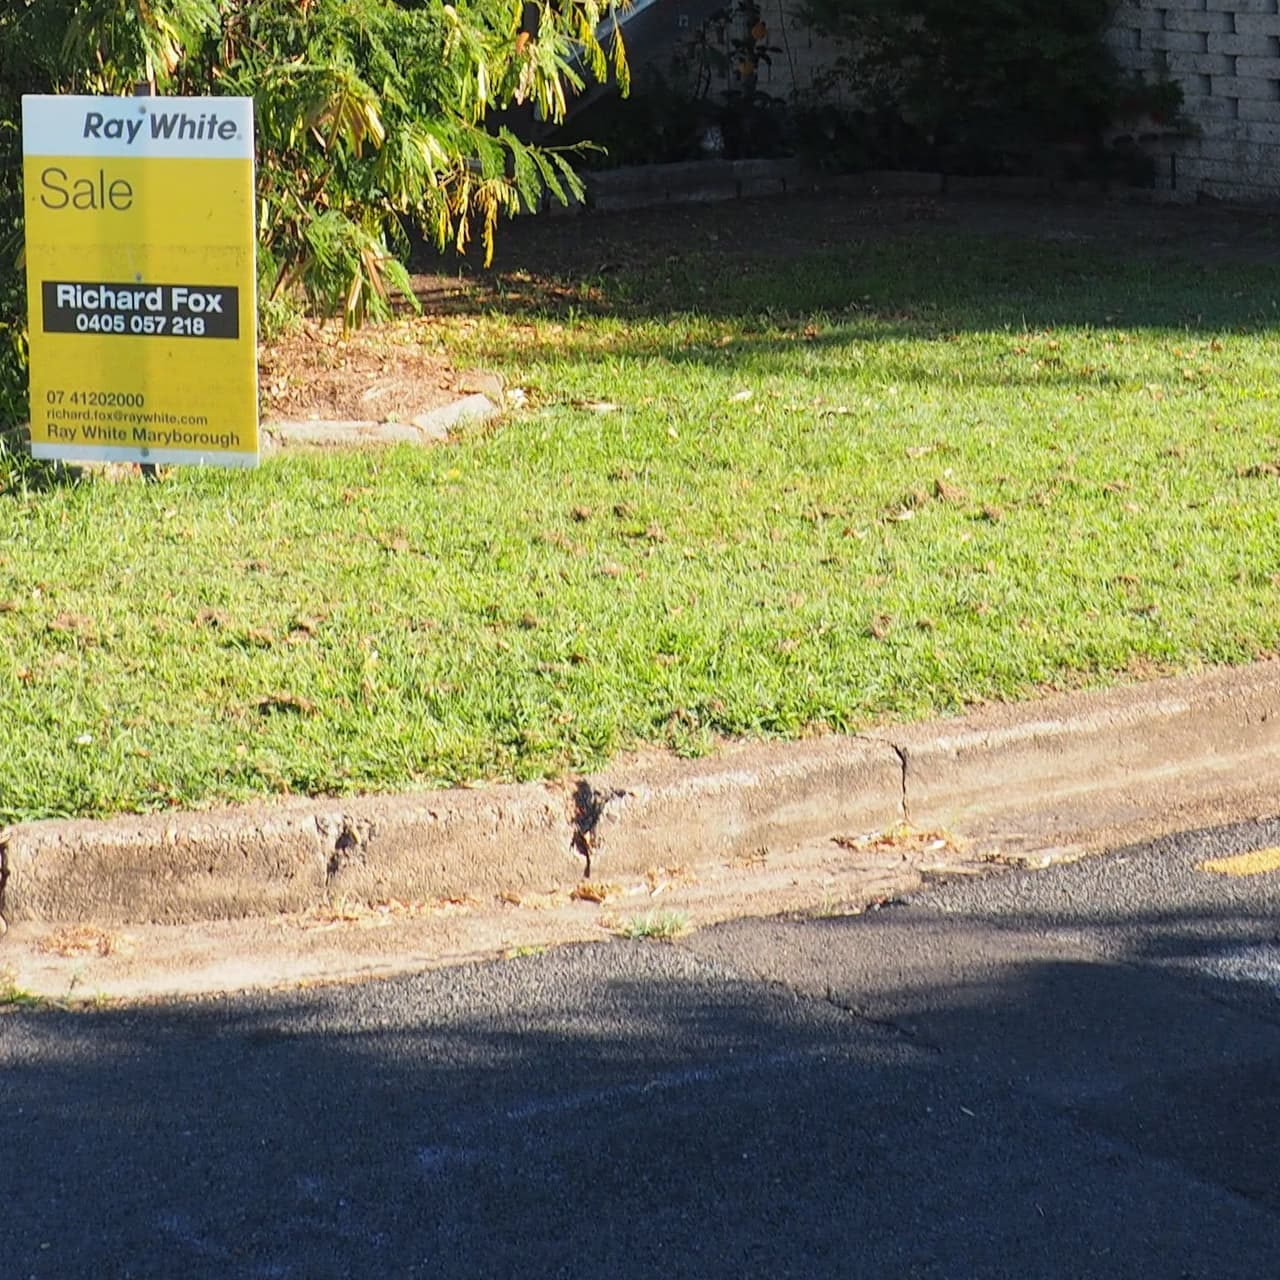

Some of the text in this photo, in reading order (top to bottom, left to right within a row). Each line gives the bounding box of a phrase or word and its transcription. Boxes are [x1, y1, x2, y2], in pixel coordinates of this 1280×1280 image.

[83, 112, 237, 144] Ray White
[40, 167, 133, 210] Sale
[56, 284, 222, 313] Richard Fox
[76, 314, 205, 335] 0405 057 218
[47, 390, 144, 407] 07 41202000
[47, 409, 208, 425] richard.fox@raywhite.com
[47, 424, 240, 448] Ray White Maryborough
